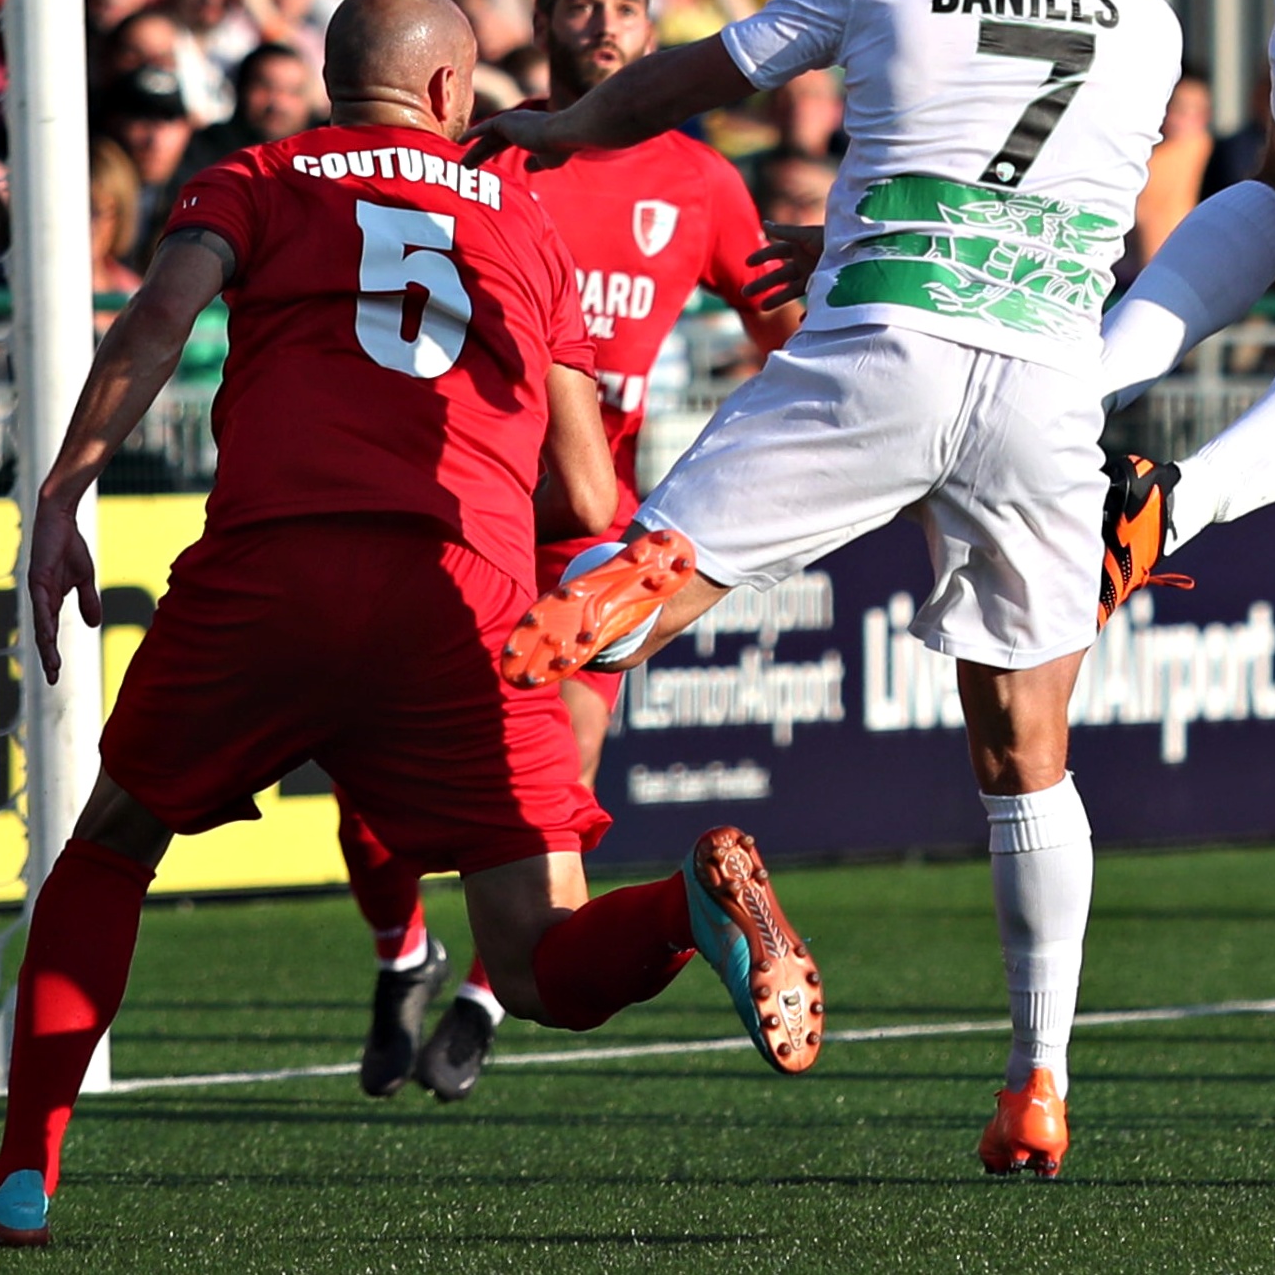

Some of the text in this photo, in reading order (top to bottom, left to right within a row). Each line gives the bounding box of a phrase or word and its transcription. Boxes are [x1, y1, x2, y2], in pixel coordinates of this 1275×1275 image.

[292, 146, 501, 212] COUTURIER
[976, 19, 1096, 189] 7
[355, 199, 472, 379] 5
